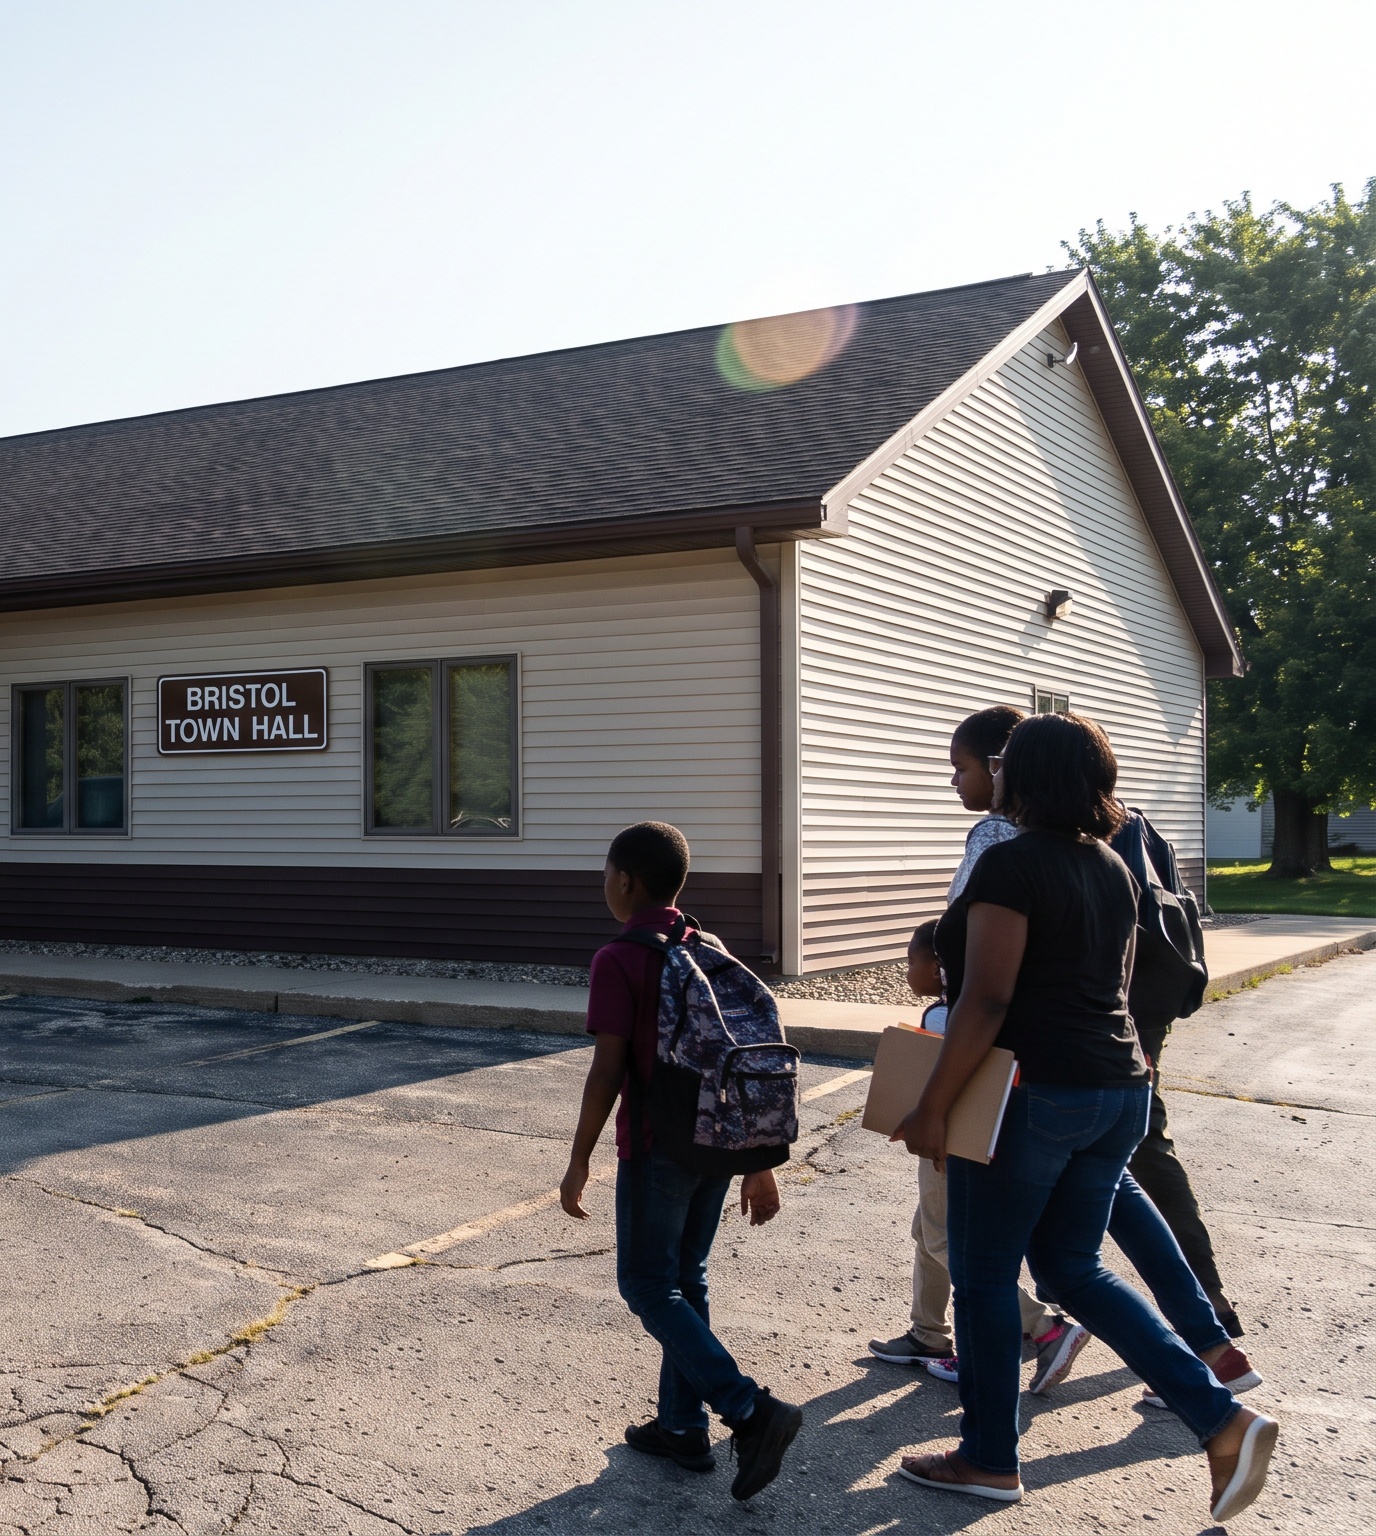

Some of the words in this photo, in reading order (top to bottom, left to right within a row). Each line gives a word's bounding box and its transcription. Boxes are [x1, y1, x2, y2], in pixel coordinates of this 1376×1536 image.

[187, 682, 296, 711] BRISTOL
[165, 717, 240, 743] TOWN
[252, 714, 318, 740] HALL
